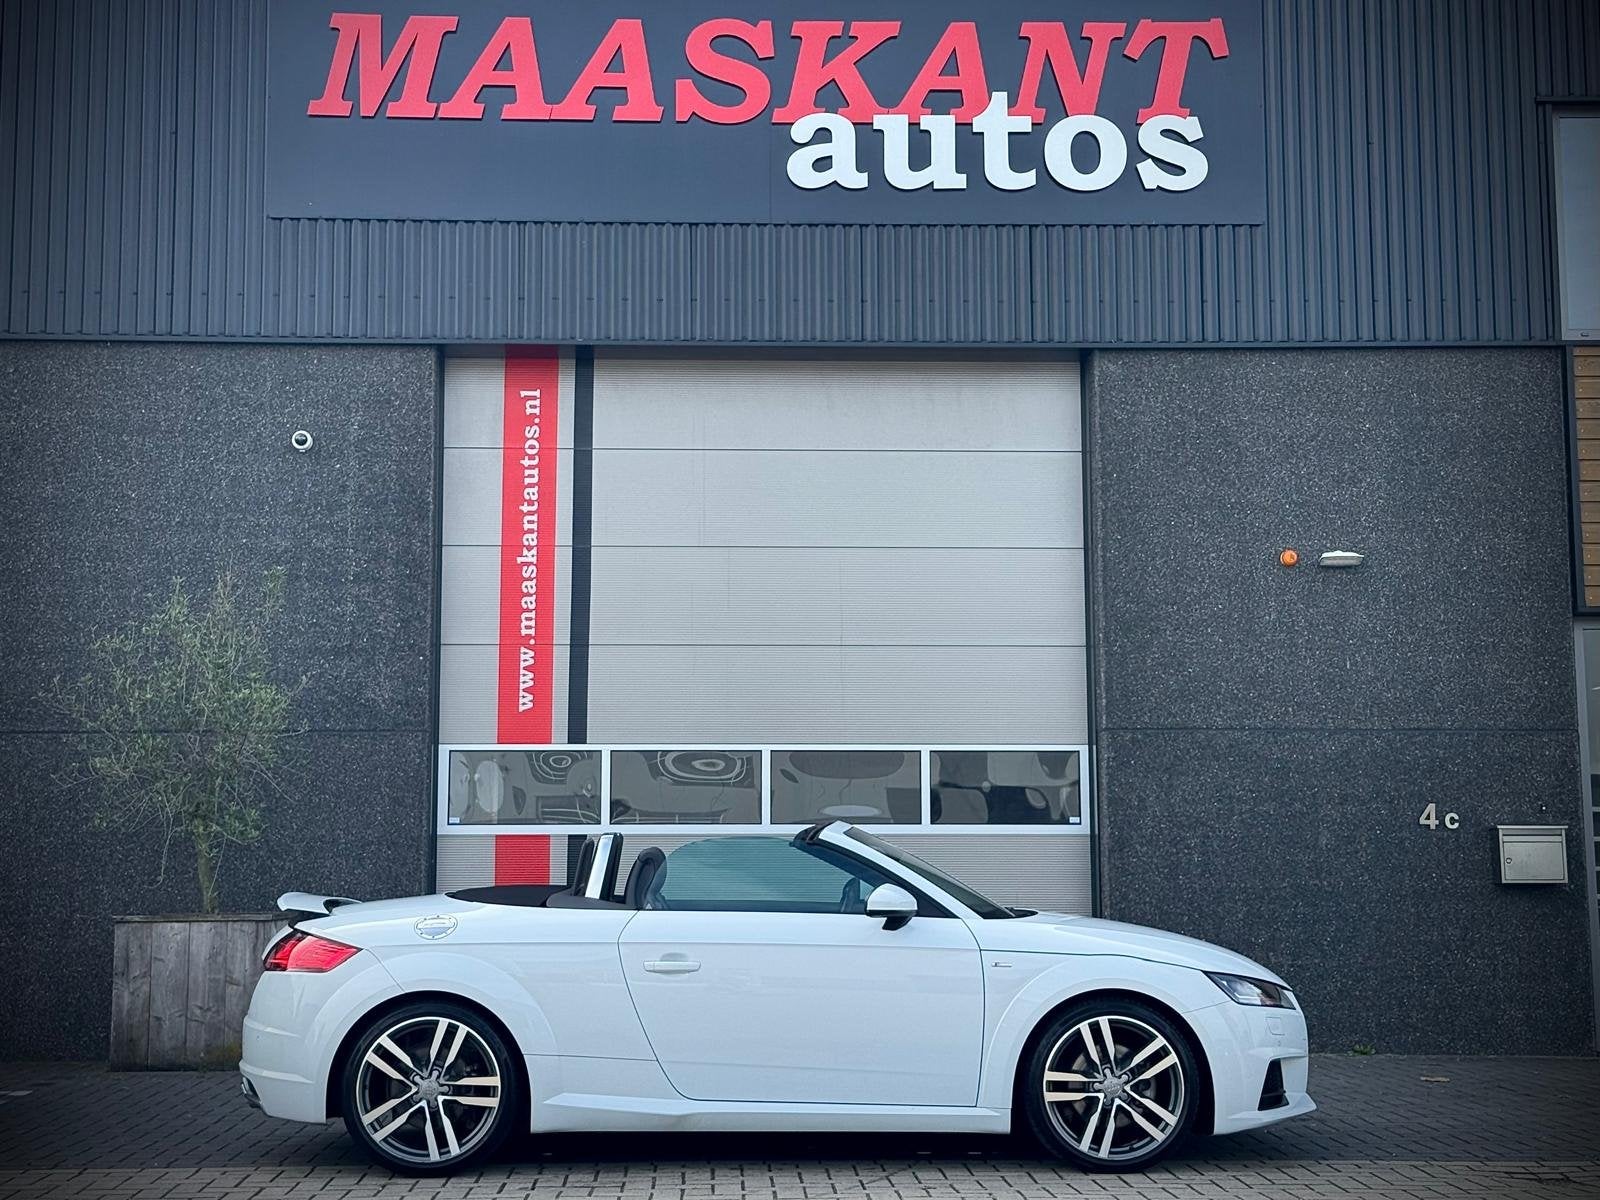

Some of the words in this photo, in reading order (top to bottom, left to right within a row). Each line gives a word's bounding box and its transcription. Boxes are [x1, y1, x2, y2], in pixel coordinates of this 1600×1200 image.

[307, 13, 1229, 124] MAASKANT
[786, 91, 1209, 191] autos
[517, 388, 541, 713] www.maaskantautos.nl
